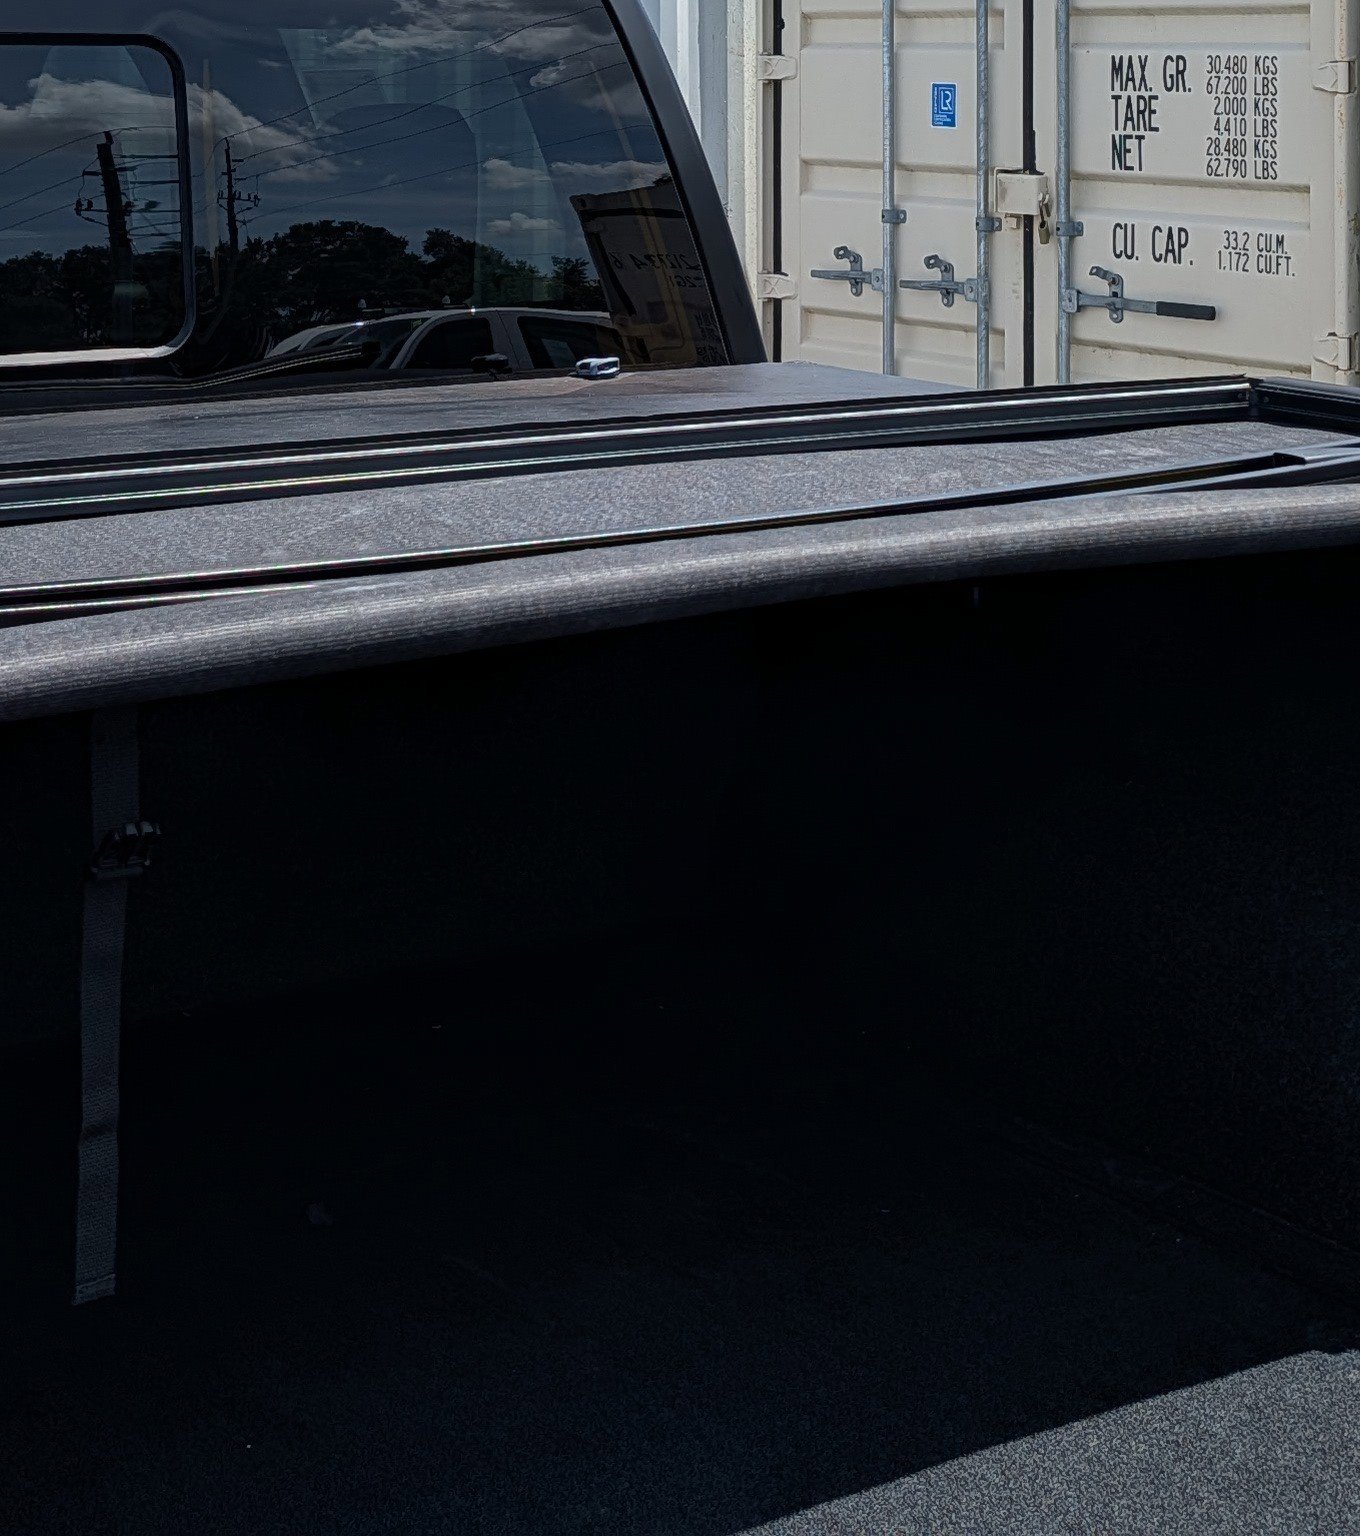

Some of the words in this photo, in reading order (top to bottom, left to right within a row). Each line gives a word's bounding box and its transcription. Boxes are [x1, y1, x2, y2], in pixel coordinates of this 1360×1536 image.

[1110, 54, 1153, 92] MAX.
[1162, 54, 1192, 93] GR.
[1254, 55, 1278, 76] KGS
[1254, 76, 1278, 96] LBS
[1110, 94, 1160, 132] TARE
[1254, 97, 1278, 118] KGS
[1254, 118, 1278, 138] LBS
[1111, 134, 1146, 172] NET
[1254, 139, 1278, 159] KGS
[1254, 160, 1278, 180] LBS
[1112, 222, 1140, 261] CU.
[1151, 225, 1194, 266] CAP.
[1223, 229, 1250, 252] 33.2
[1256, 232, 1288, 255] CU.M.
[1256, 254, 1296, 277] CU.FT.
